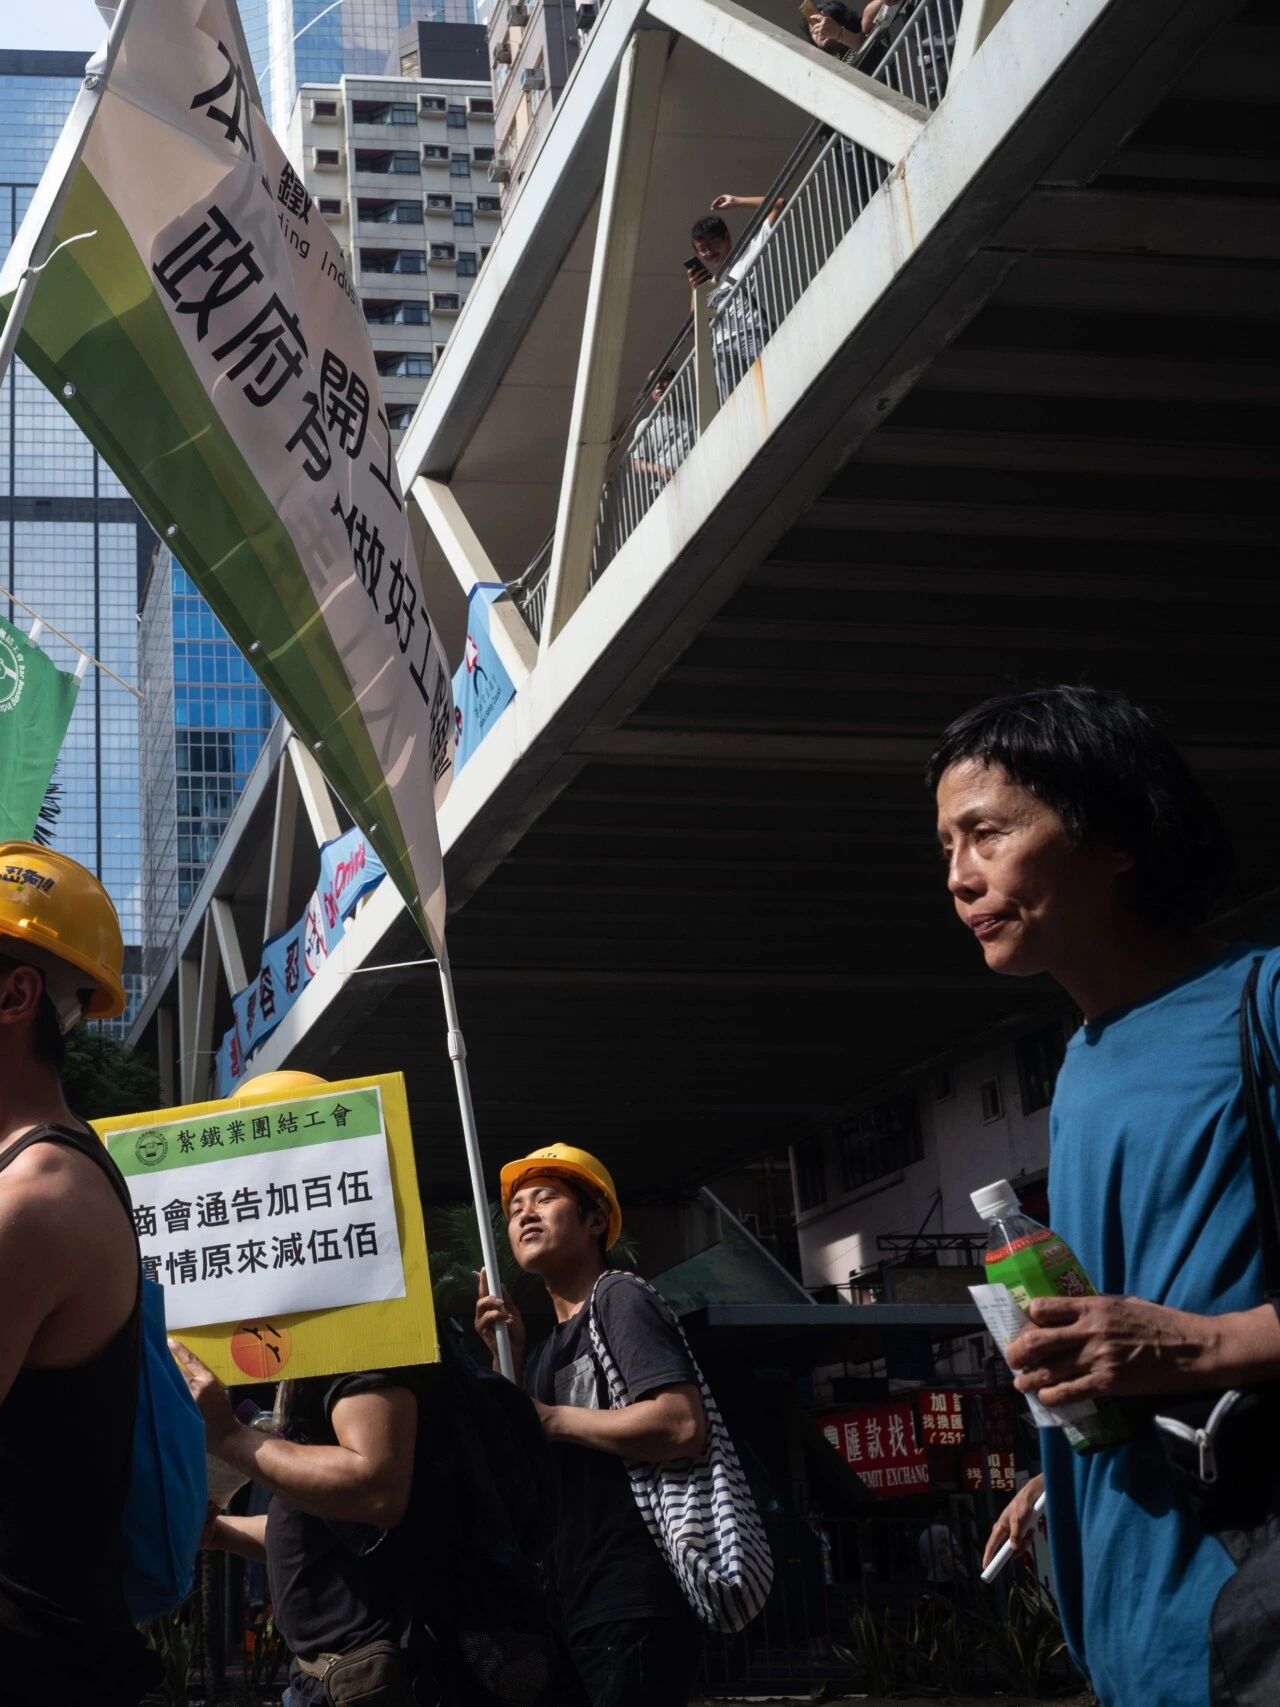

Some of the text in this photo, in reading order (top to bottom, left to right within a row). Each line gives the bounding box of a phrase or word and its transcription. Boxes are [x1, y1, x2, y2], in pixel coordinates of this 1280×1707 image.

[176, 1102, 353, 1155] 紮鐵業團結工會
